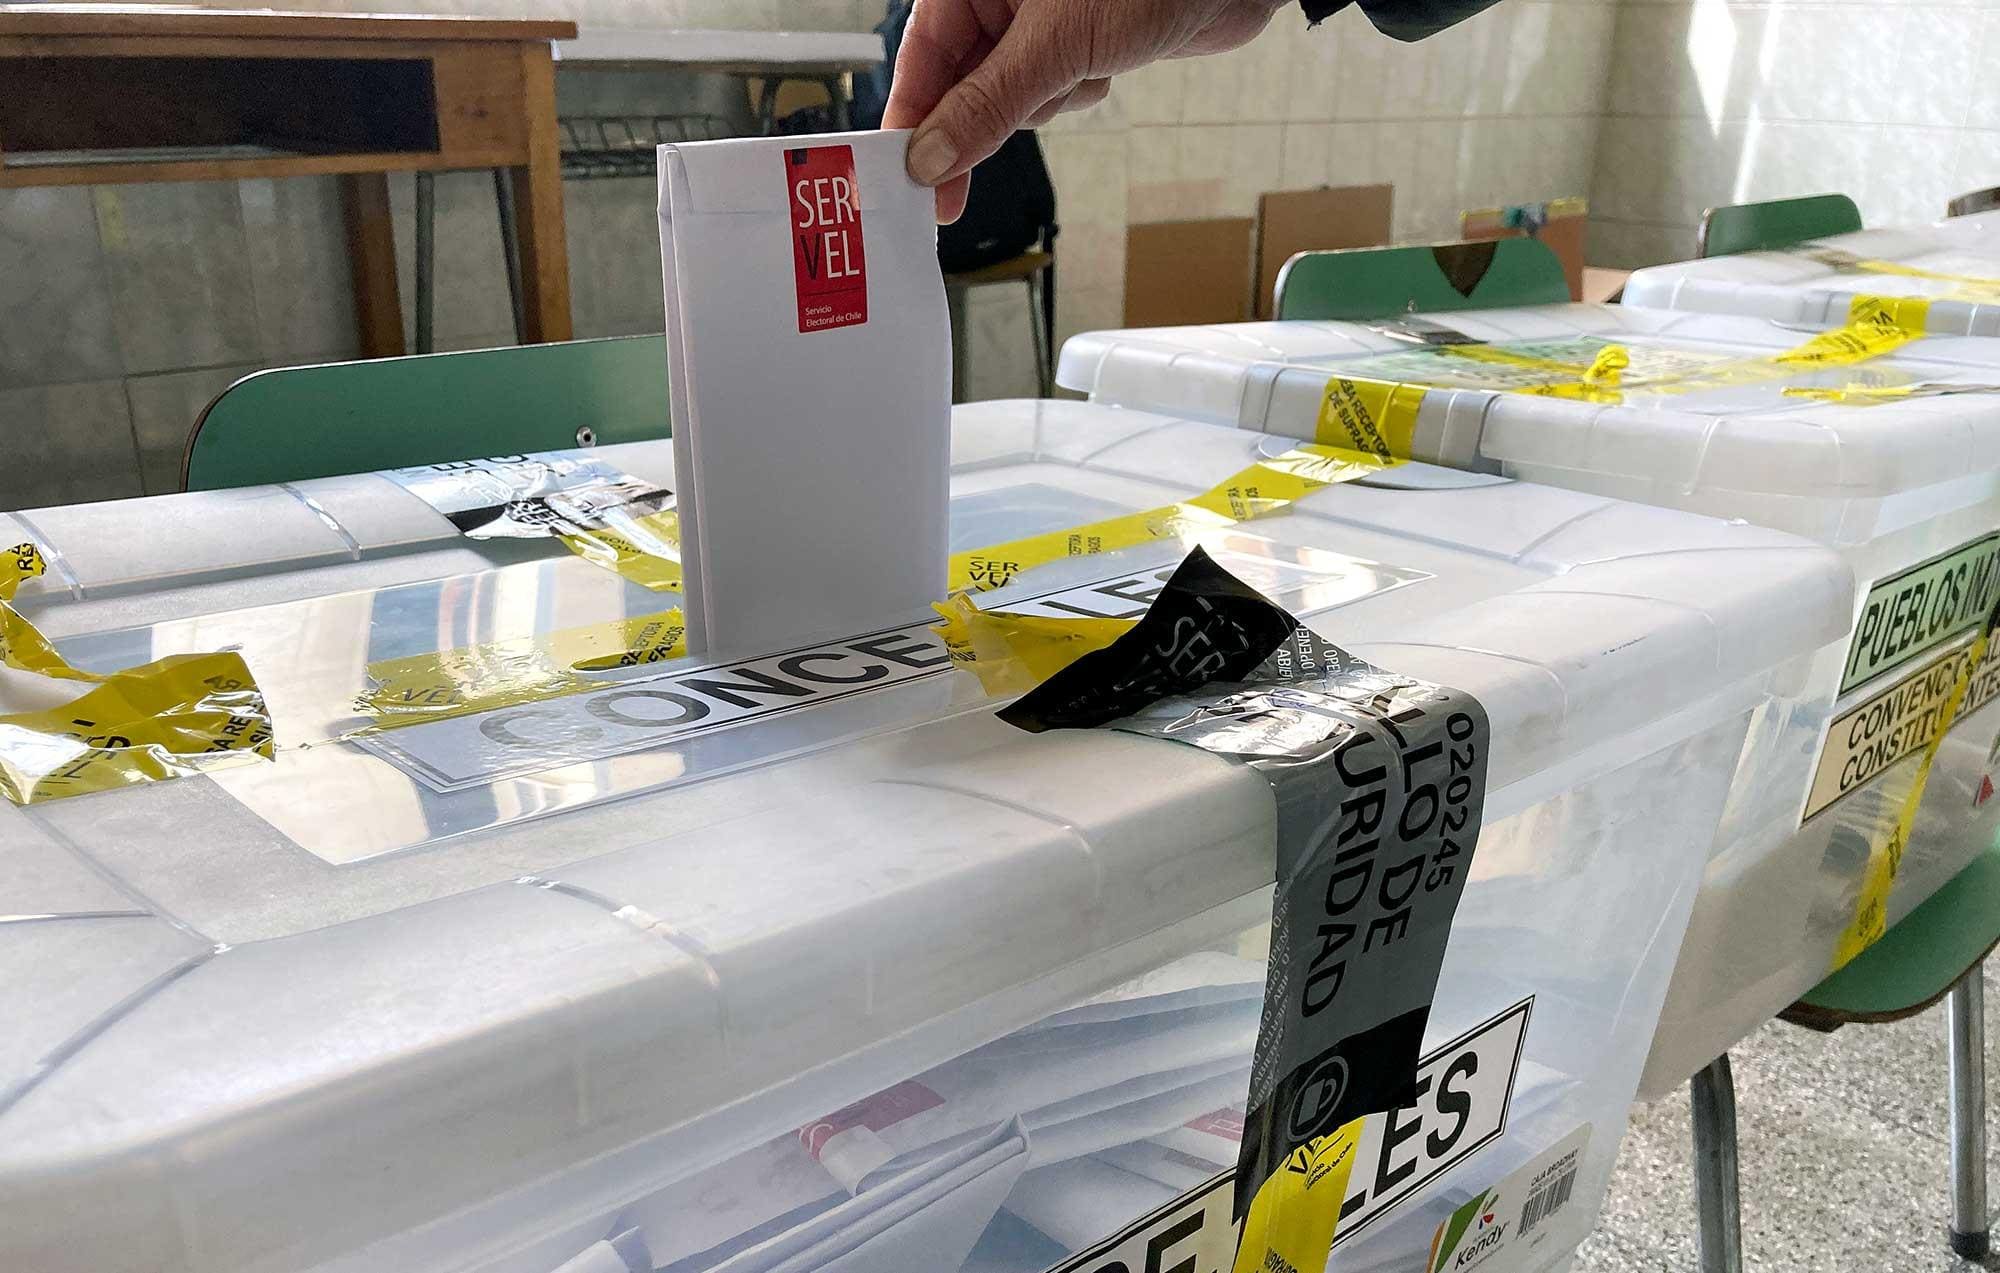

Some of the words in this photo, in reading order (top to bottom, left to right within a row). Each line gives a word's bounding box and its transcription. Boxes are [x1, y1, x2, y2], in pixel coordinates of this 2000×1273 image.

[795, 176, 855, 228] SER
[800, 230, 860, 281] VEL
[804, 304, 832, 316] Servicio
[806, 314, 835, 328] Electoral
[835, 314, 845, 323] de
[845, 311, 862, 321] Chile
[1328, 389, 1344, 409] DE
[1338, 407, 1370, 453] SUFRAG
[969, 561, 1019, 572] SER
[1851, 562, 1967, 677] PUEBLOS
[1424, 712, 1475, 892] 020245
[1362, 854, 1426, 954] DE
[1454, 1221, 1510, 1271] Kendy
